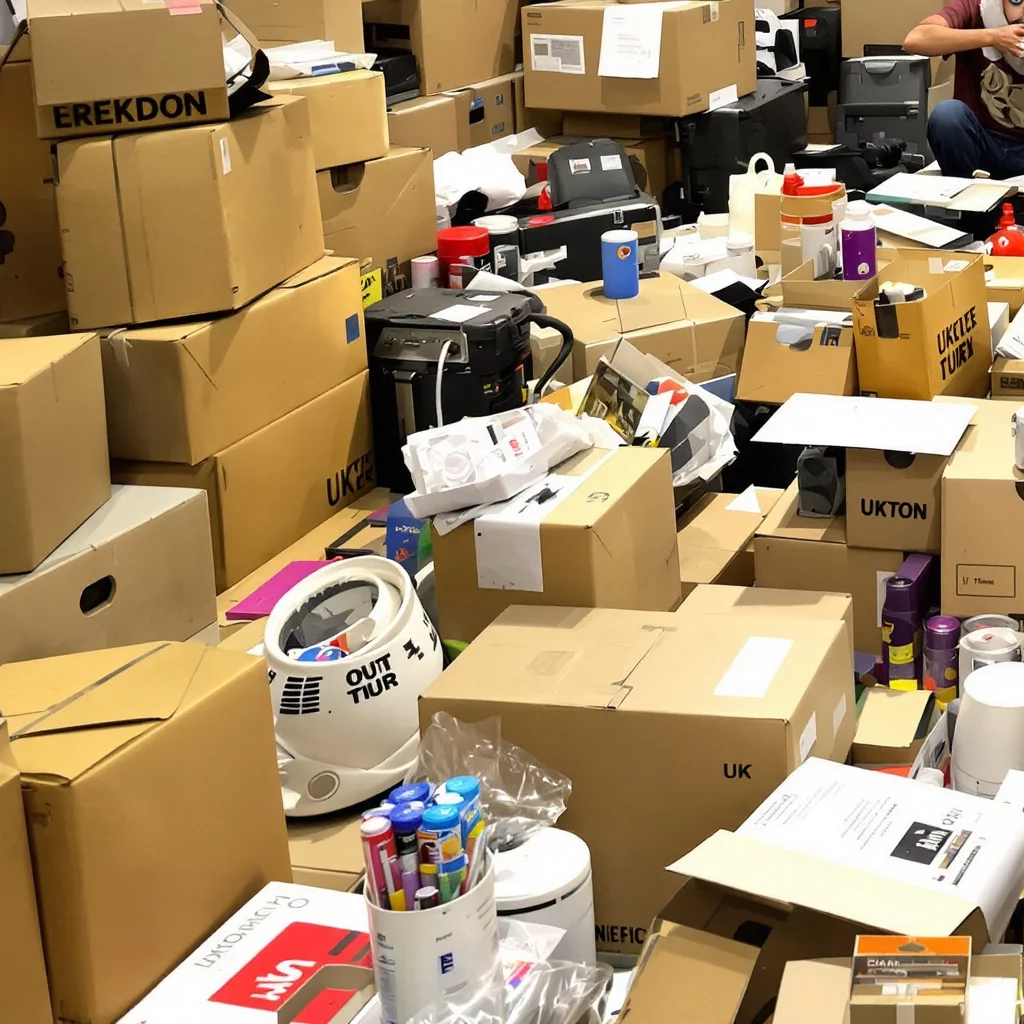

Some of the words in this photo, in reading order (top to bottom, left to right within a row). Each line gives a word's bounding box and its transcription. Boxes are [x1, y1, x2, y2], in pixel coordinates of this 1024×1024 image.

[52, 91, 208, 129] EREKDON
[860, 498, 928, 520] UKTON
[723, 763, 753, 779] UK
